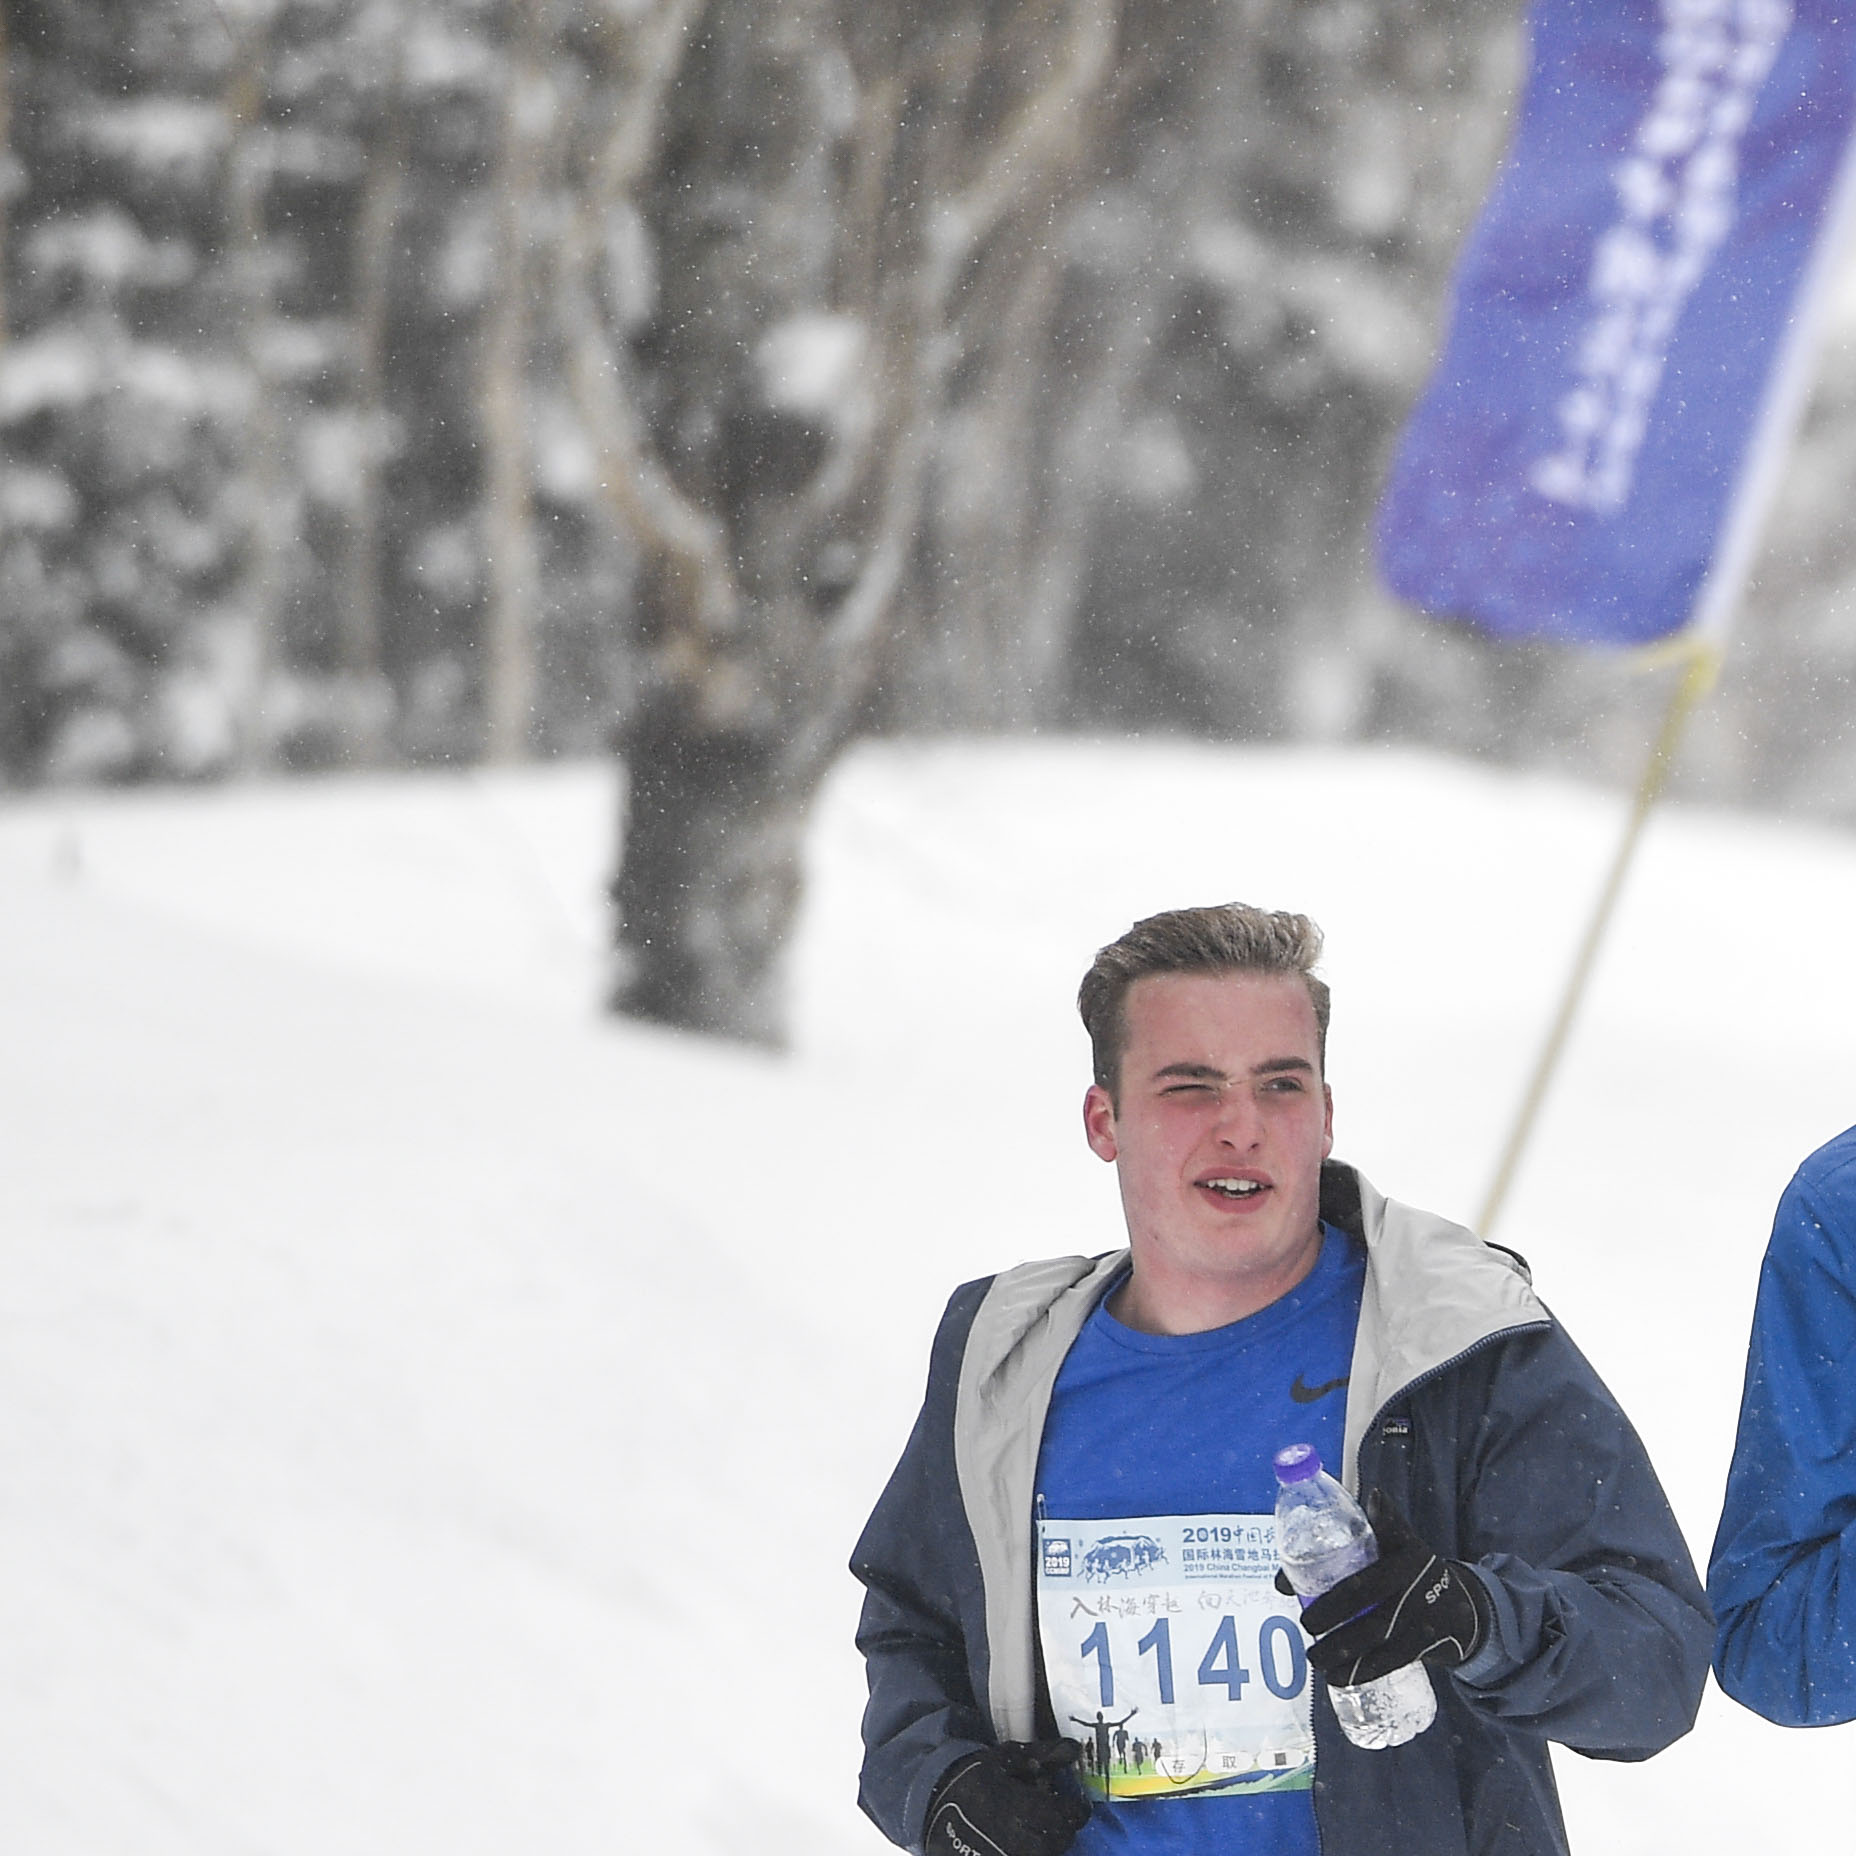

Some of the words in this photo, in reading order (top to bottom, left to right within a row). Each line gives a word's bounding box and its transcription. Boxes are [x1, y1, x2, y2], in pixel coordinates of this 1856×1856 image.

[1382, 1425, 1409, 1434] onia
[1045, 1556, 1070, 1568] 2019
[1184, 1563, 1205, 1572] 2019
[1207, 1563, 1230, 1571] China
[1080, 1615, 1307, 1708] 1140
[1222, 1755, 1237, 1769] 取
